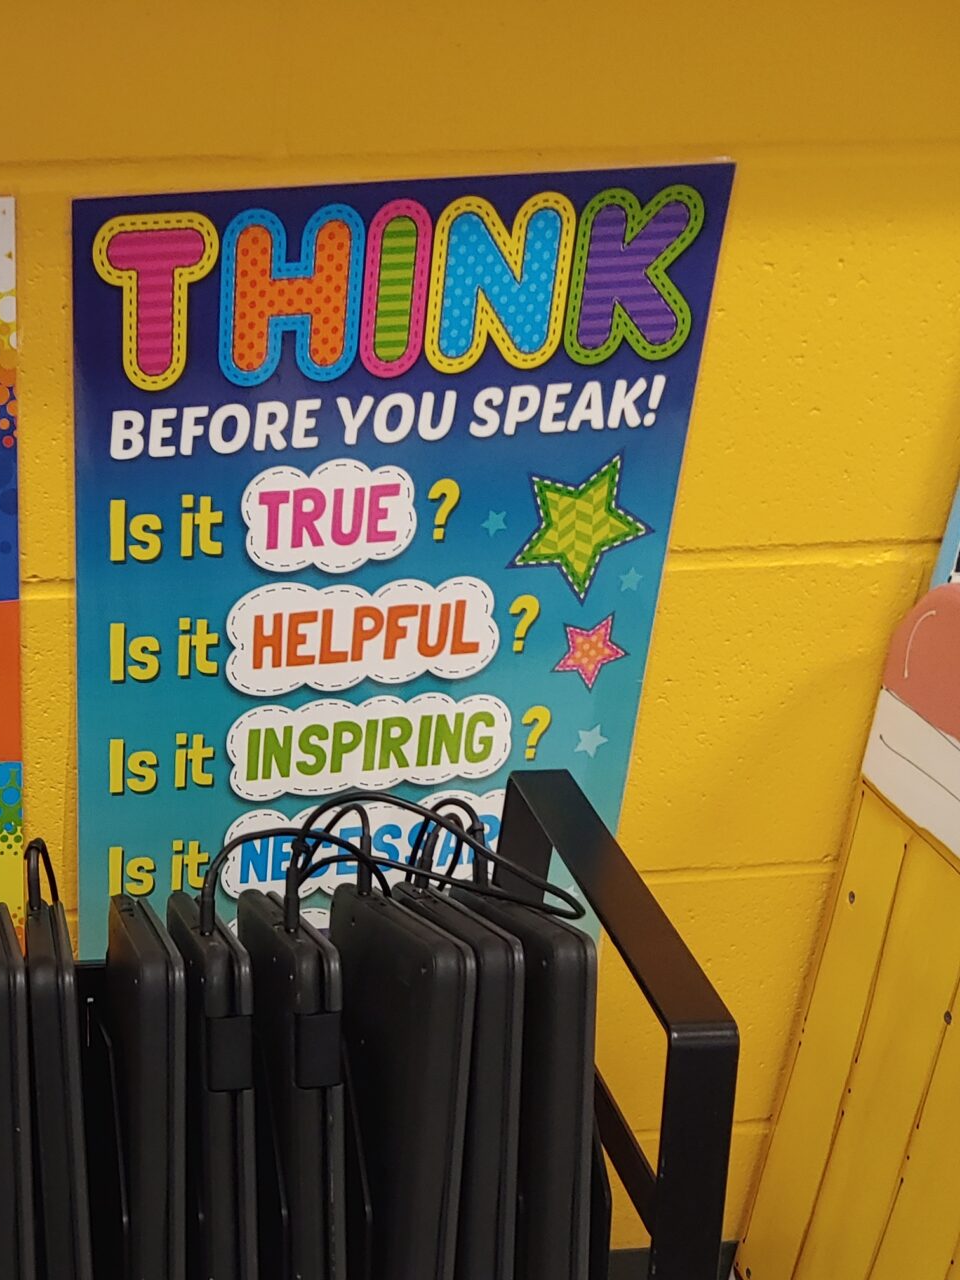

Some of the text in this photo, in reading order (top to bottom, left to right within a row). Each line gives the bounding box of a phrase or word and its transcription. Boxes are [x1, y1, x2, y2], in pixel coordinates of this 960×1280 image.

[93, 184, 706, 391] THINK
[109, 374, 667, 460] BEFORE YOU SPEAK!
[109, 478, 461, 562] Is it TRUE ?
[109, 595, 540, 682] Is it HELPFUL ?
[108, 706, 552, 794] Is it INSPIRING ?
[107, 813, 501, 897] Is it NEESSAR
